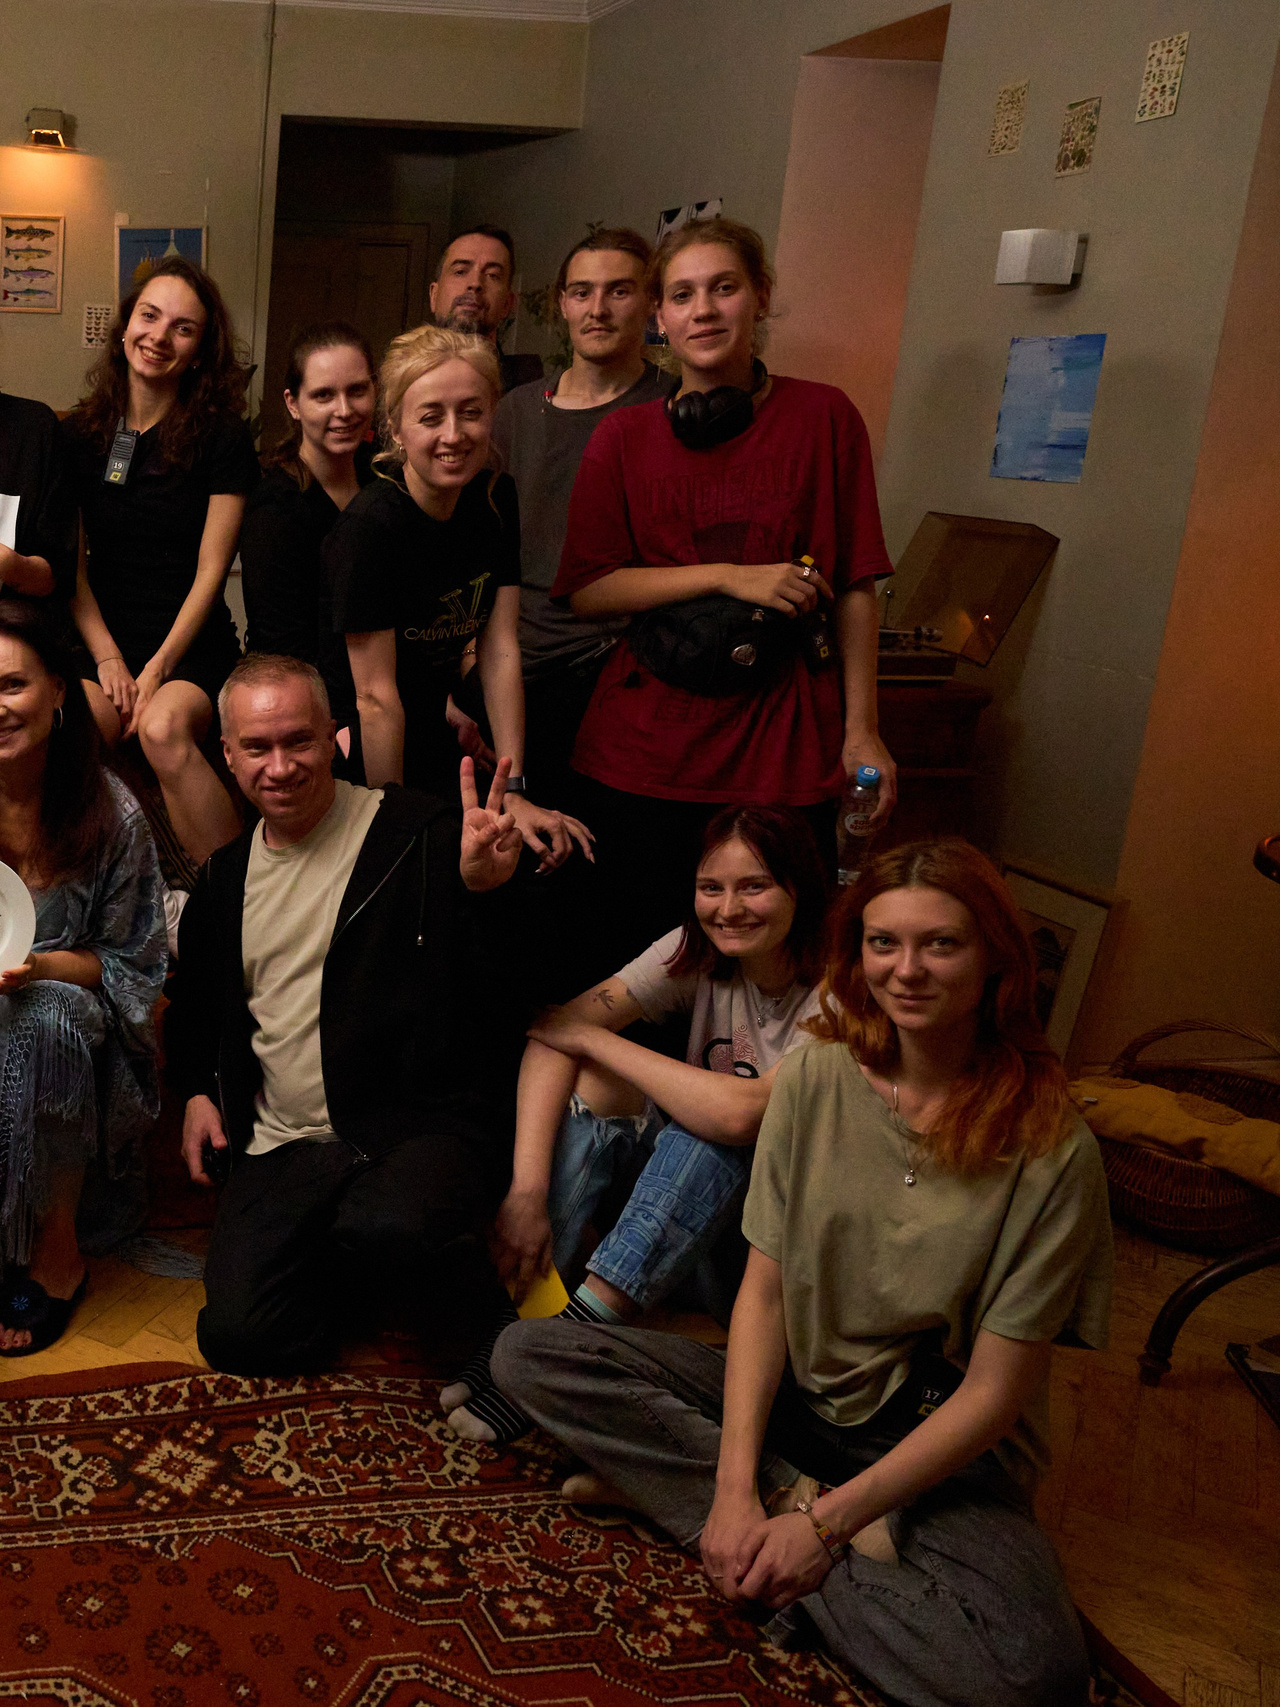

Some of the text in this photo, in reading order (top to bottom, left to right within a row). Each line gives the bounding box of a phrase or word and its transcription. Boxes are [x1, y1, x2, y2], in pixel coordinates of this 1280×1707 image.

[114, 462, 123, 470] 19
[404, 626, 450, 641] CALVIN
[924, 1390, 940, 1401] 17
